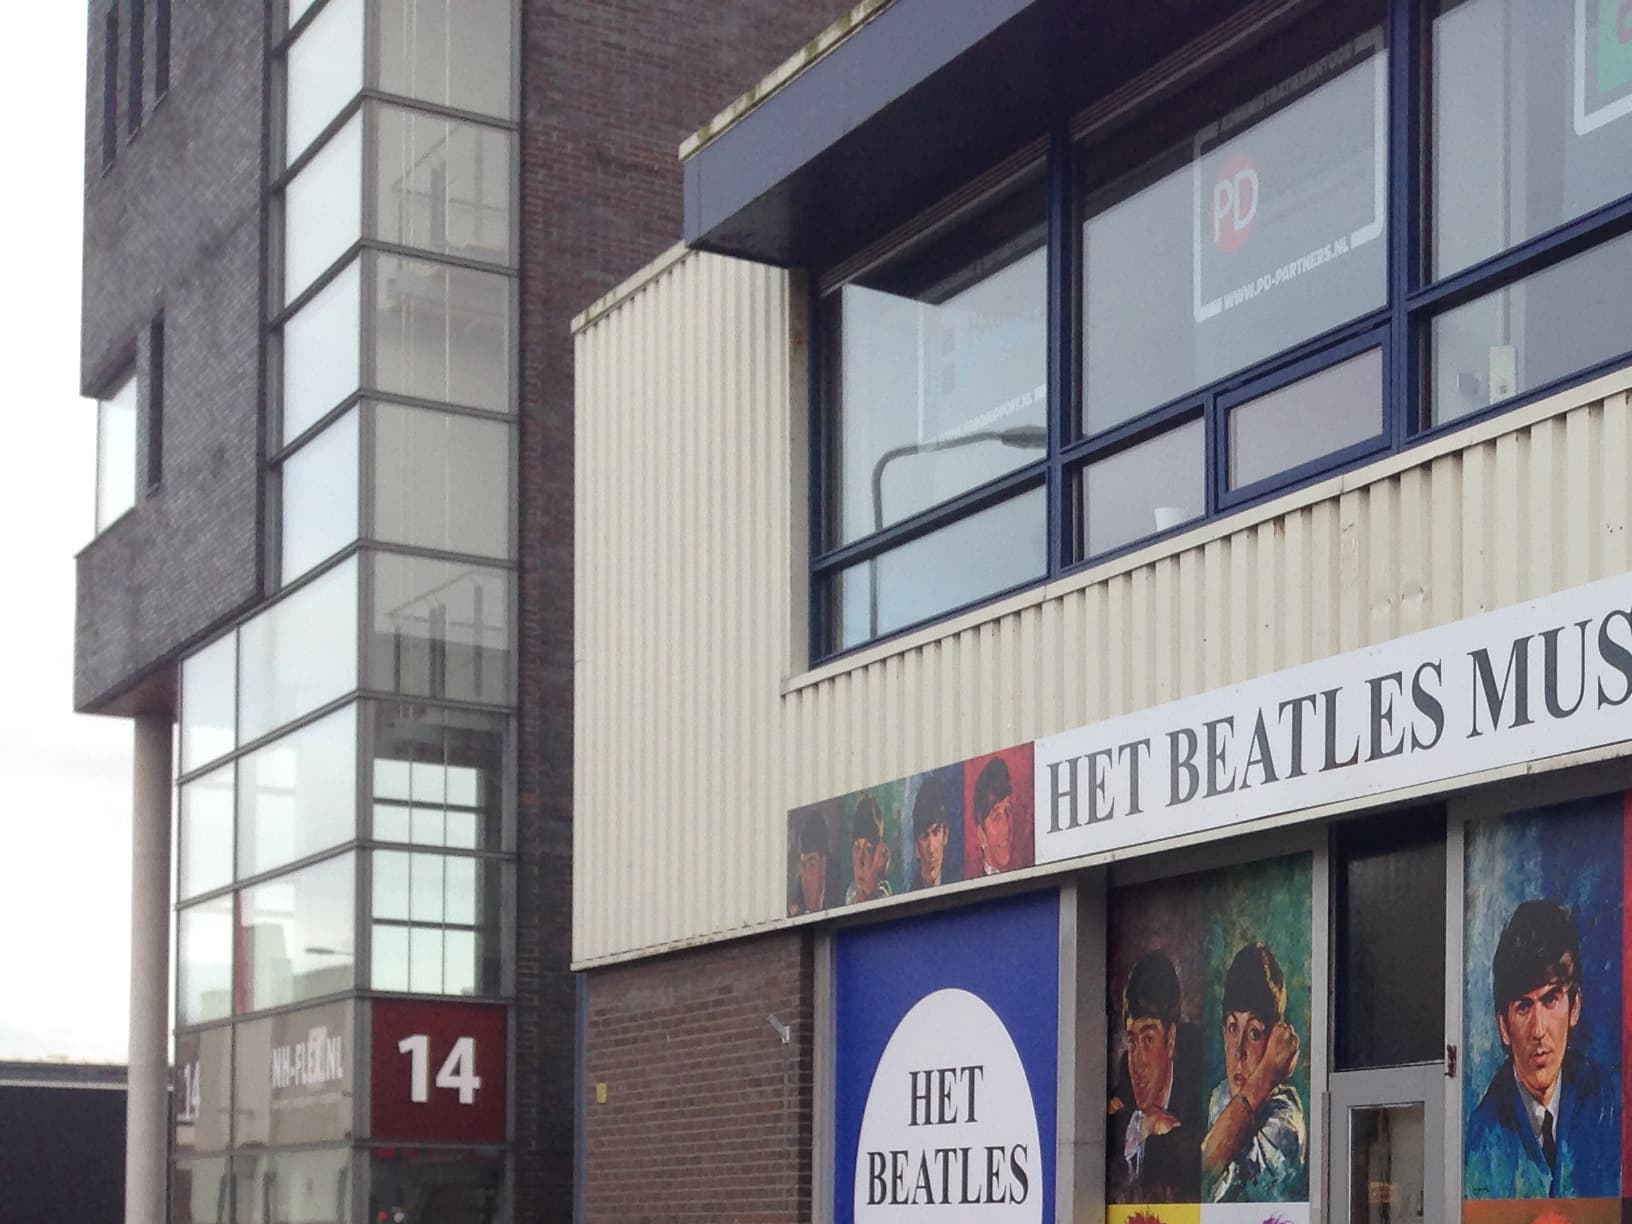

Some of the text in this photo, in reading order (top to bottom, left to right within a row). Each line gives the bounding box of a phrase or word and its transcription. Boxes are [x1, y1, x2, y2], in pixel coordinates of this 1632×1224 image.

[1214, 169, 1259, 242] PD
[1046, 738, 1151, 834] HET
[1165, 660, 1446, 810] BEATLES
[398, 1034, 481, 1105] 14
[908, 1064, 984, 1127] HET
[866, 1143, 1029, 1206] BEATLES
